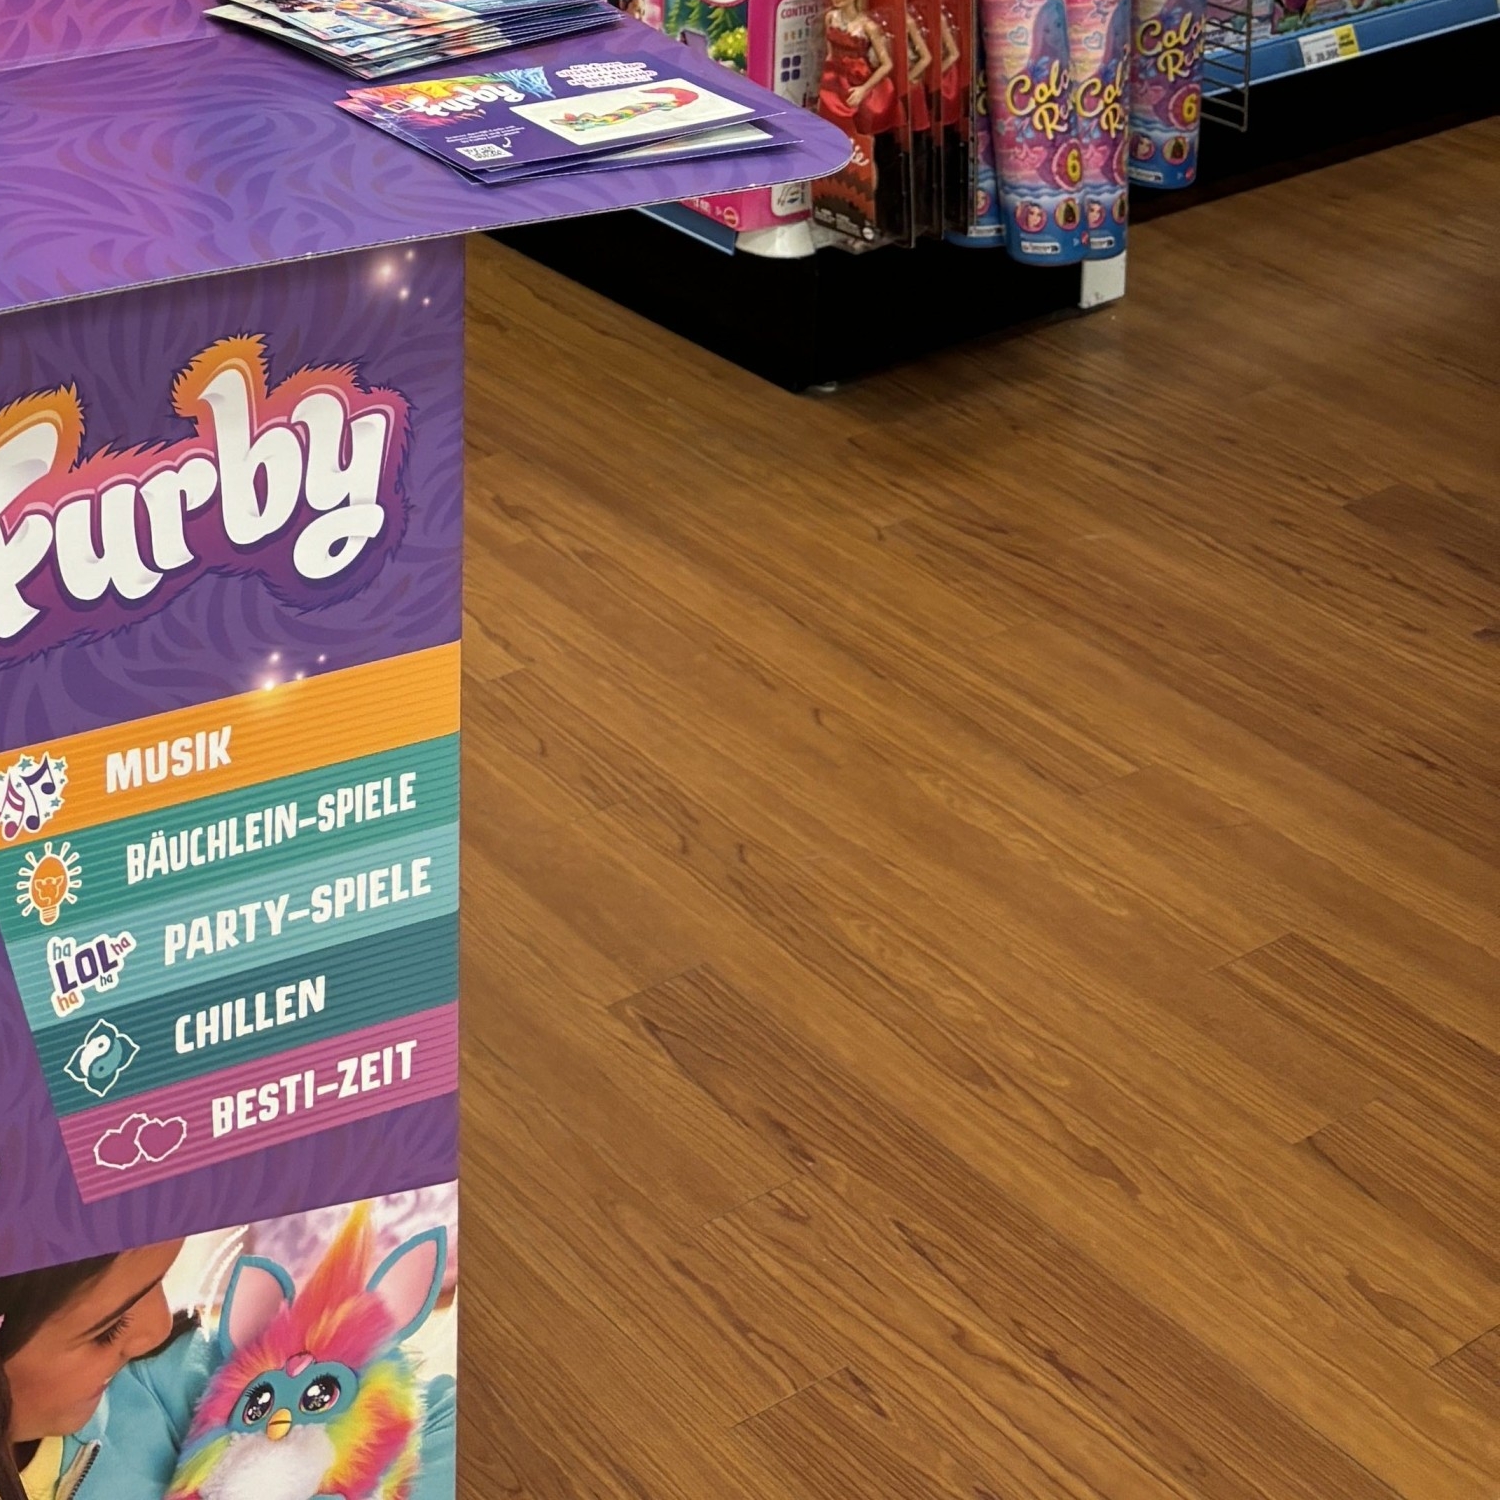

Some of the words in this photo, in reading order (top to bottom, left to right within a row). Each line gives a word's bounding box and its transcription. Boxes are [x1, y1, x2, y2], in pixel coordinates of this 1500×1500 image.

[410, 83, 525, 118] Furby
[1006, 59, 1071, 117] Colo
[1075, 60, 1124, 118] Col
[1183, 93, 1197, 120] 6
[1066, 149, 1081, 183] 6
[105, 725, 233, 794] MUSIK
[125, 772, 418, 884] BÄUCHLEIN-SPIELE
[163, 857, 432, 966] PARTY-SPIELE
[52, 940, 72, 960] ha
[55, 942, 123, 994] LOL
[110, 935, 131, 955] ha
[56, 990, 78, 1012] ha
[174, 975, 327, 1056] CHILLEN
[212, 1039, 418, 1138] BESTI-ZEIT
